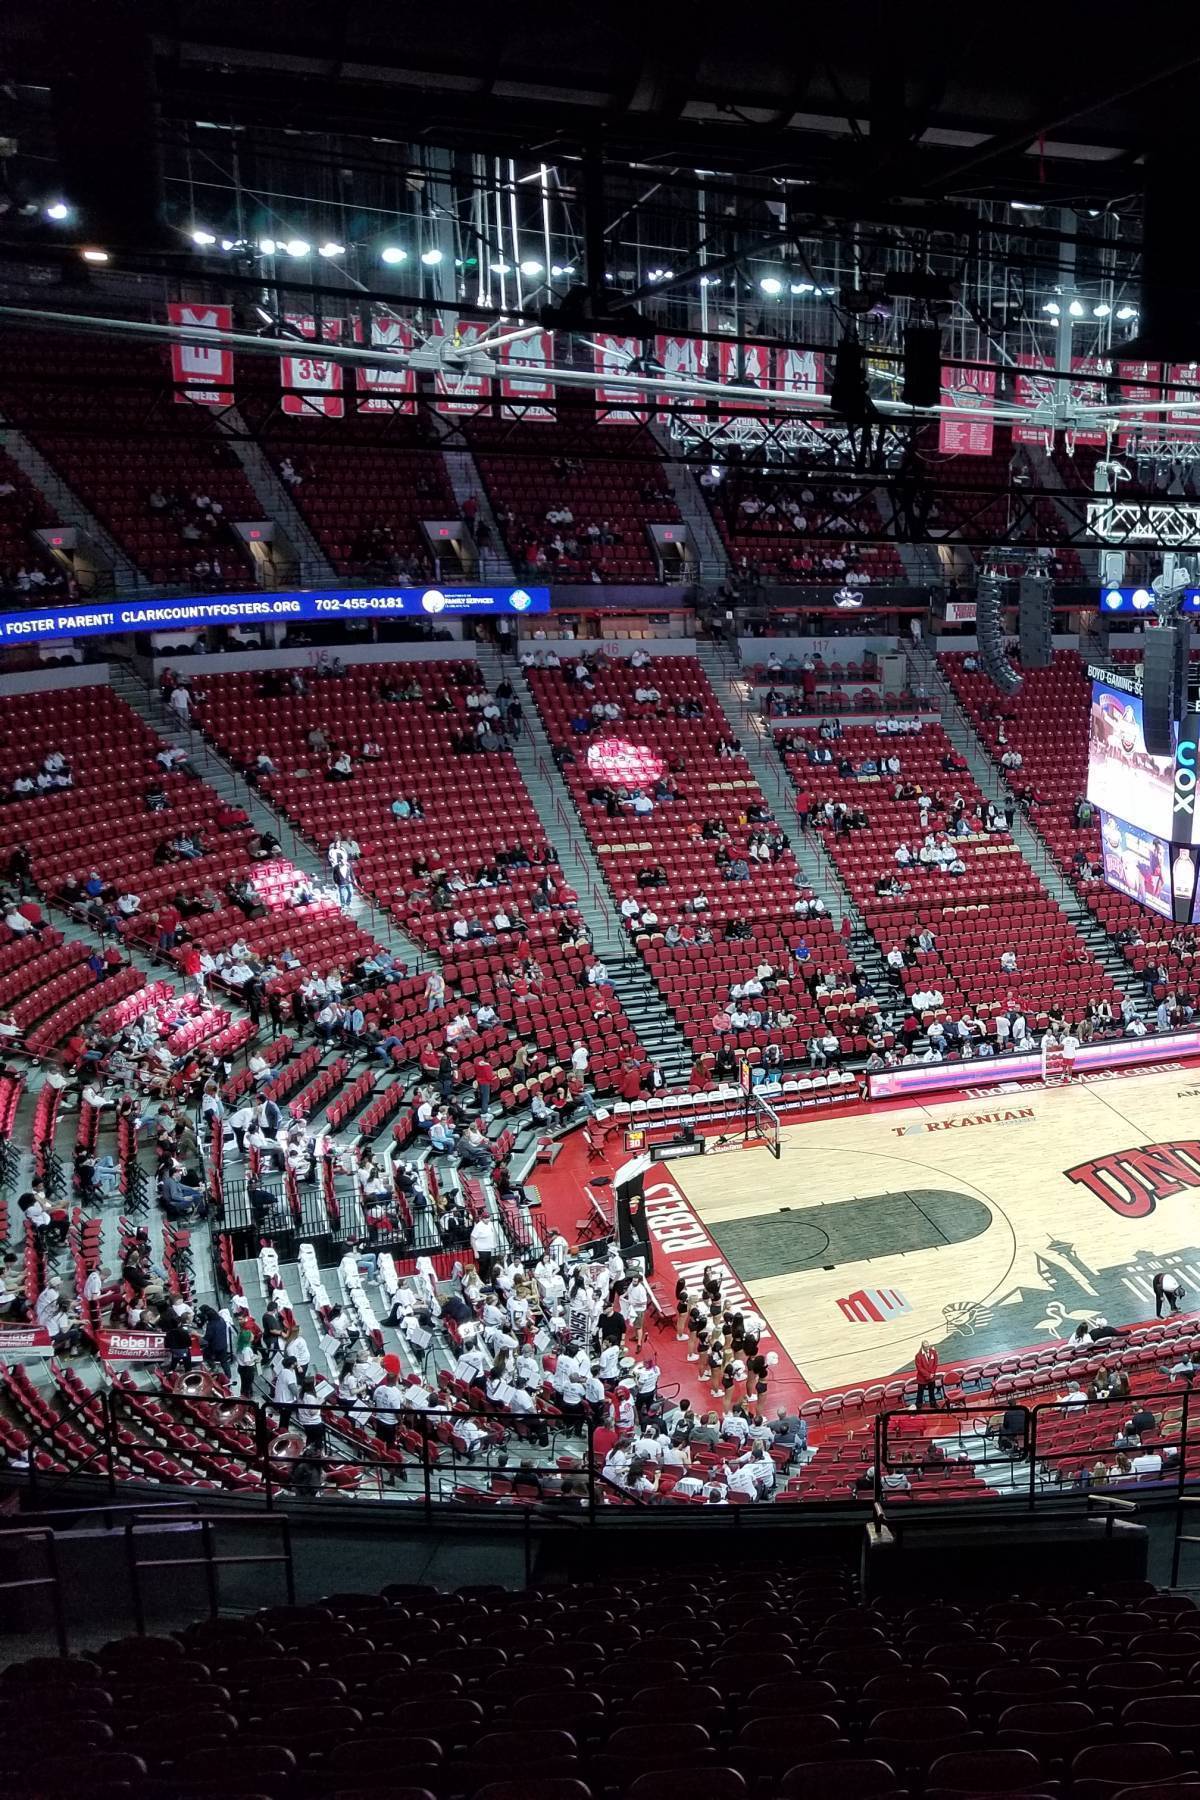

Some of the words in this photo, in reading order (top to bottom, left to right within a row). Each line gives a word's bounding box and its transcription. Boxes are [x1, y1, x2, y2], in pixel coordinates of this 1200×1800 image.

[6, 618, 55, 635] FOSTER
[58, 613, 114, 629] PARENT!
[121, 601, 300, 623] CLARKCOUNTYFOSTERS.ORG
[315, 597, 404, 611] 702-455-0181
[813, 640, 829, 652] 117
[1088, 665, 1105, 681] BOYD
[1106, 671, 1133, 692] GAMING
[1173, 741, 1196, 814] COX
[962, 1080, 1043, 1099] Thoas
[1124, 1062, 1186, 1078] CENTER
[628, 1139, 641, 1149] 30
[644, 1183, 712, 1254] REBELS
[108, 1348, 143, 1356] Student
[110, 1335, 149, 1348] Rebel
